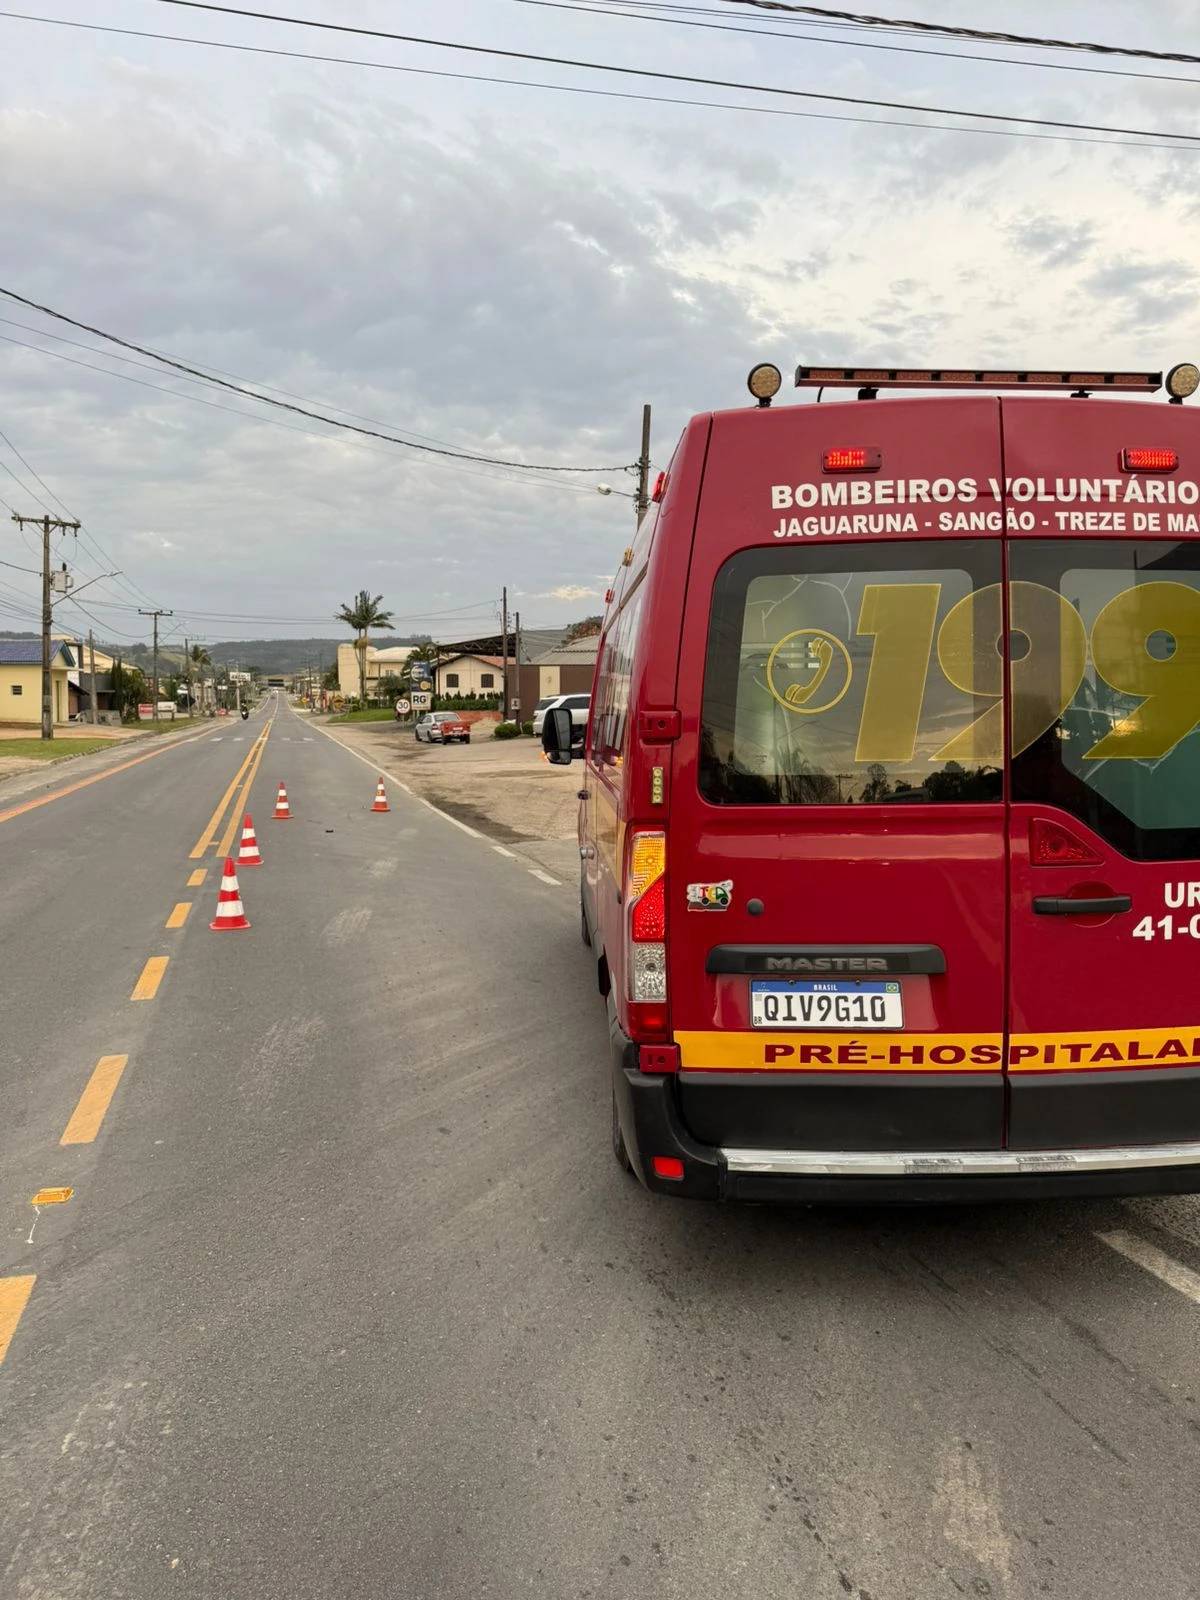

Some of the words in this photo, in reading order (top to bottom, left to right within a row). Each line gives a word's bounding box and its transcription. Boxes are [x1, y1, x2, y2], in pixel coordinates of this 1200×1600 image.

[771, 478, 977, 509] BOMBEIROS
[988, 474, 1199, 504] VOLUNTÁRIO
[773, 513, 918, 537] JAGUARUNA
[939, 507, 1035, 531] SANGÃO
[1055, 511, 1126, 531] TREZE
[1133, 512, 1161, 531] DE
[1167, 513, 1200, 532] MA
[855, 581, 1200, 763] 199
[398, 701, 409, 709] 30
[767, 957, 888, 971] MASTER
[754, 1016, 762, 1024] BR
[764, 995, 886, 1022] QIV9G10
